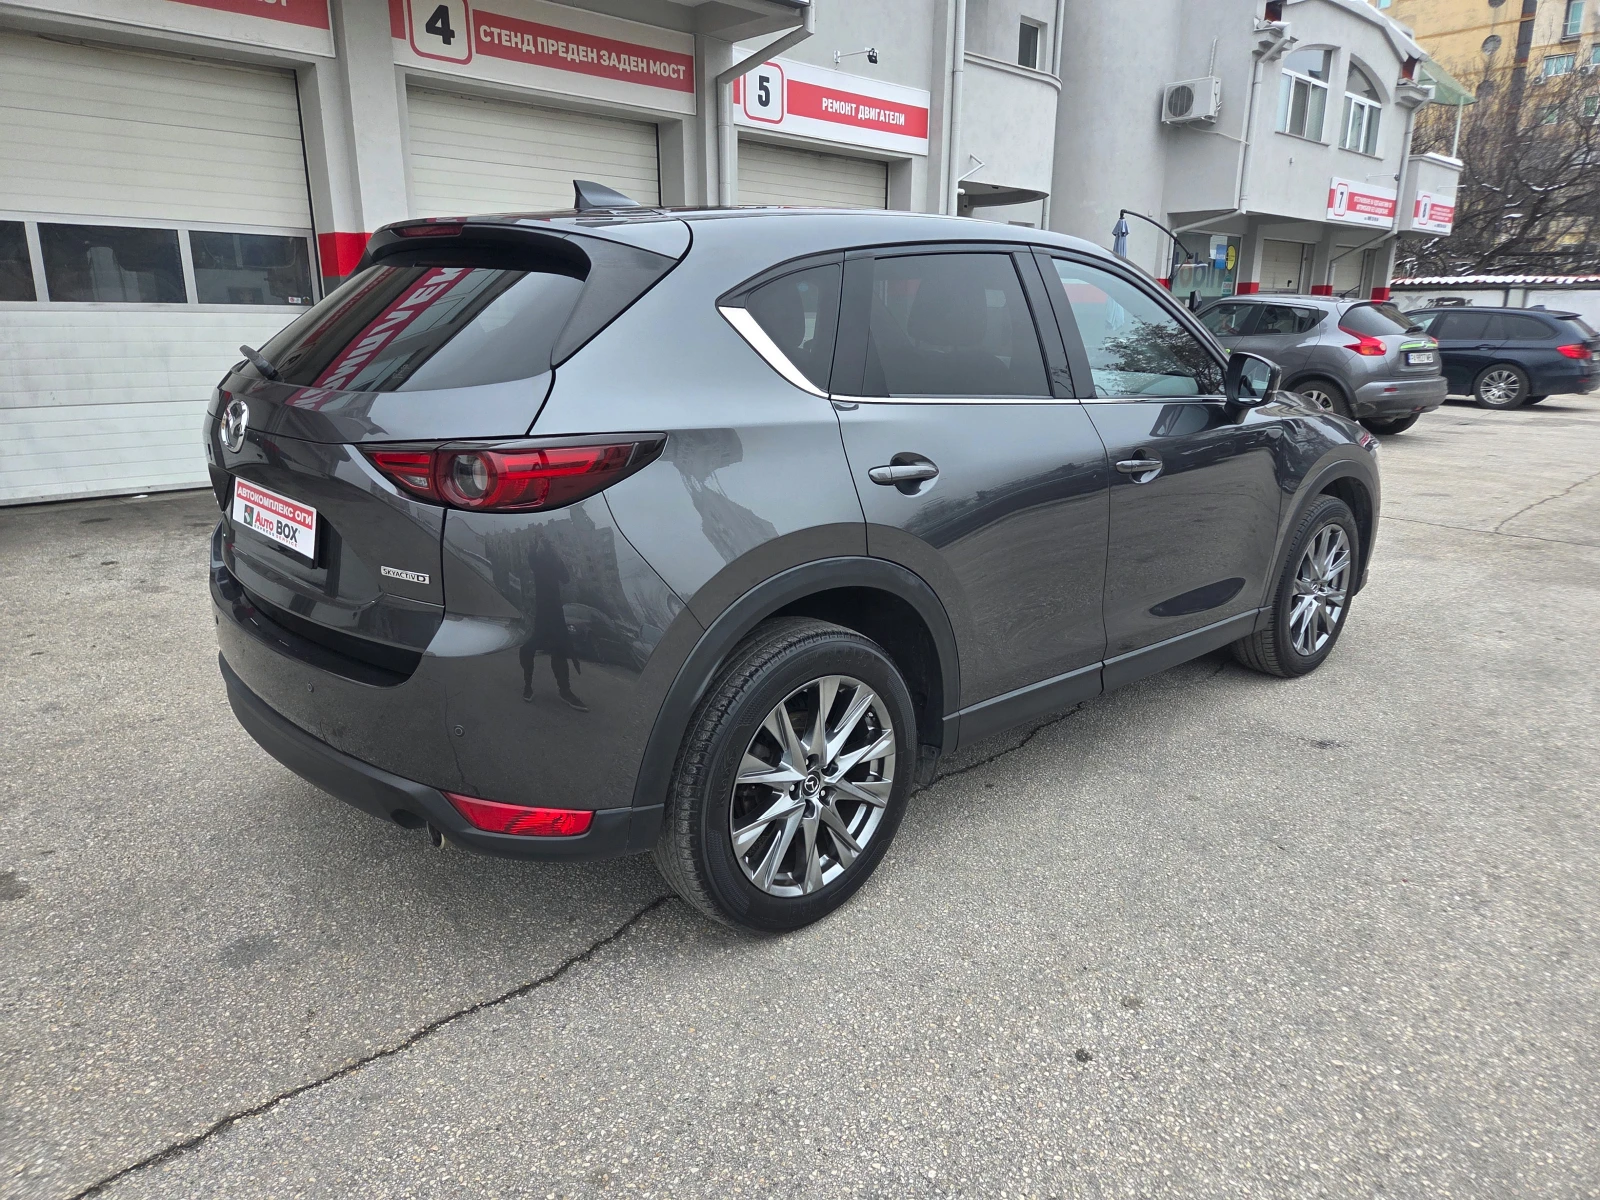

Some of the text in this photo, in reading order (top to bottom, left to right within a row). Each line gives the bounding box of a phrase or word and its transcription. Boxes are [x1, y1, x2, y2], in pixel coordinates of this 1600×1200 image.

[425, 4, 455, 46] 4
[479, 25, 686, 80] СТЕНД ПРЕДЕН ЗАДЕН МОСТ
[757, 75, 771, 107] 5
[822, 97, 905, 126] РЕМОНТ ДВИГАТЕЛИ
[1338, 191, 1345, 209] 7
[237, 486, 312, 526] АВТОКОМПЛЕКС ОГИ
[276, 519, 298, 544] BOX
[276, 534, 298, 548] SERVICE
